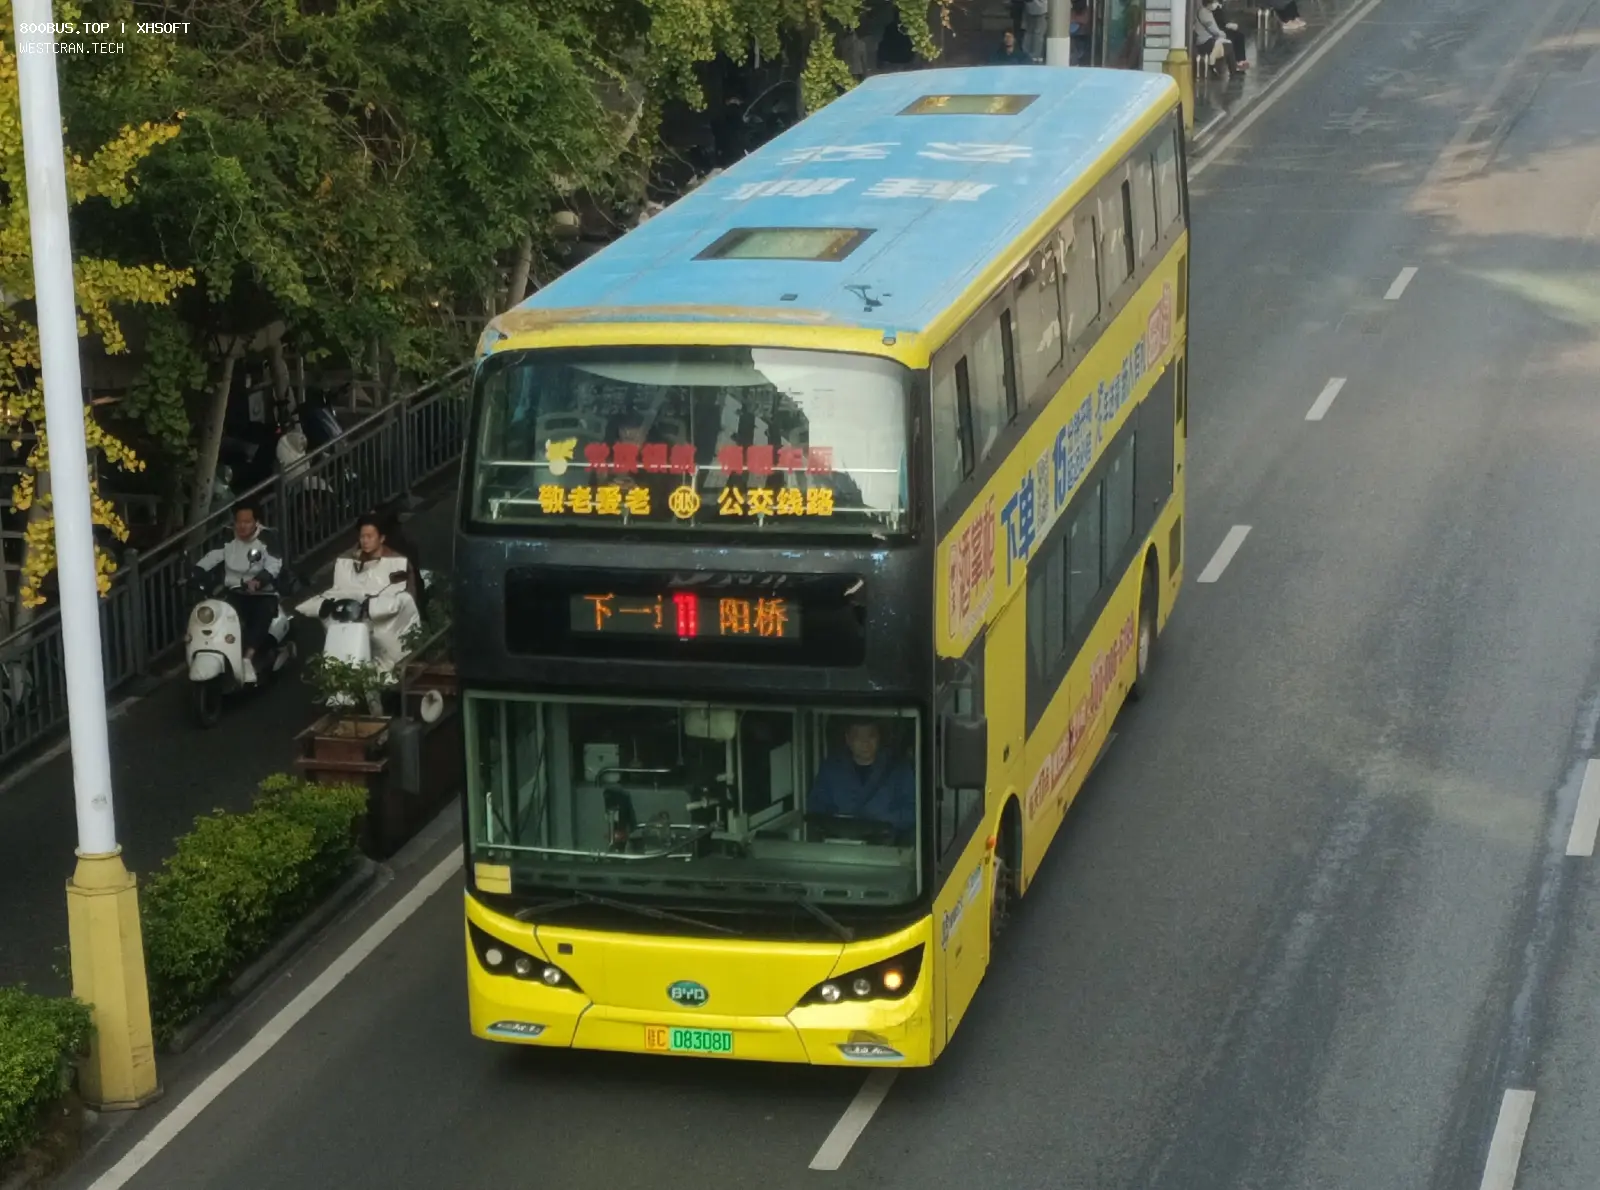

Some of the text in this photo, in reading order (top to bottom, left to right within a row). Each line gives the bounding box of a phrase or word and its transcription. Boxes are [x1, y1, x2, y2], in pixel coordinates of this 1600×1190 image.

[538, 484, 652, 516] 敬老爱老
[717, 487, 835, 517] 公交线路
[719, 596, 789, 638] 阳桥
[671, 986, 706, 1001] BYD
[673, 1030, 732, 1052] 08308D
